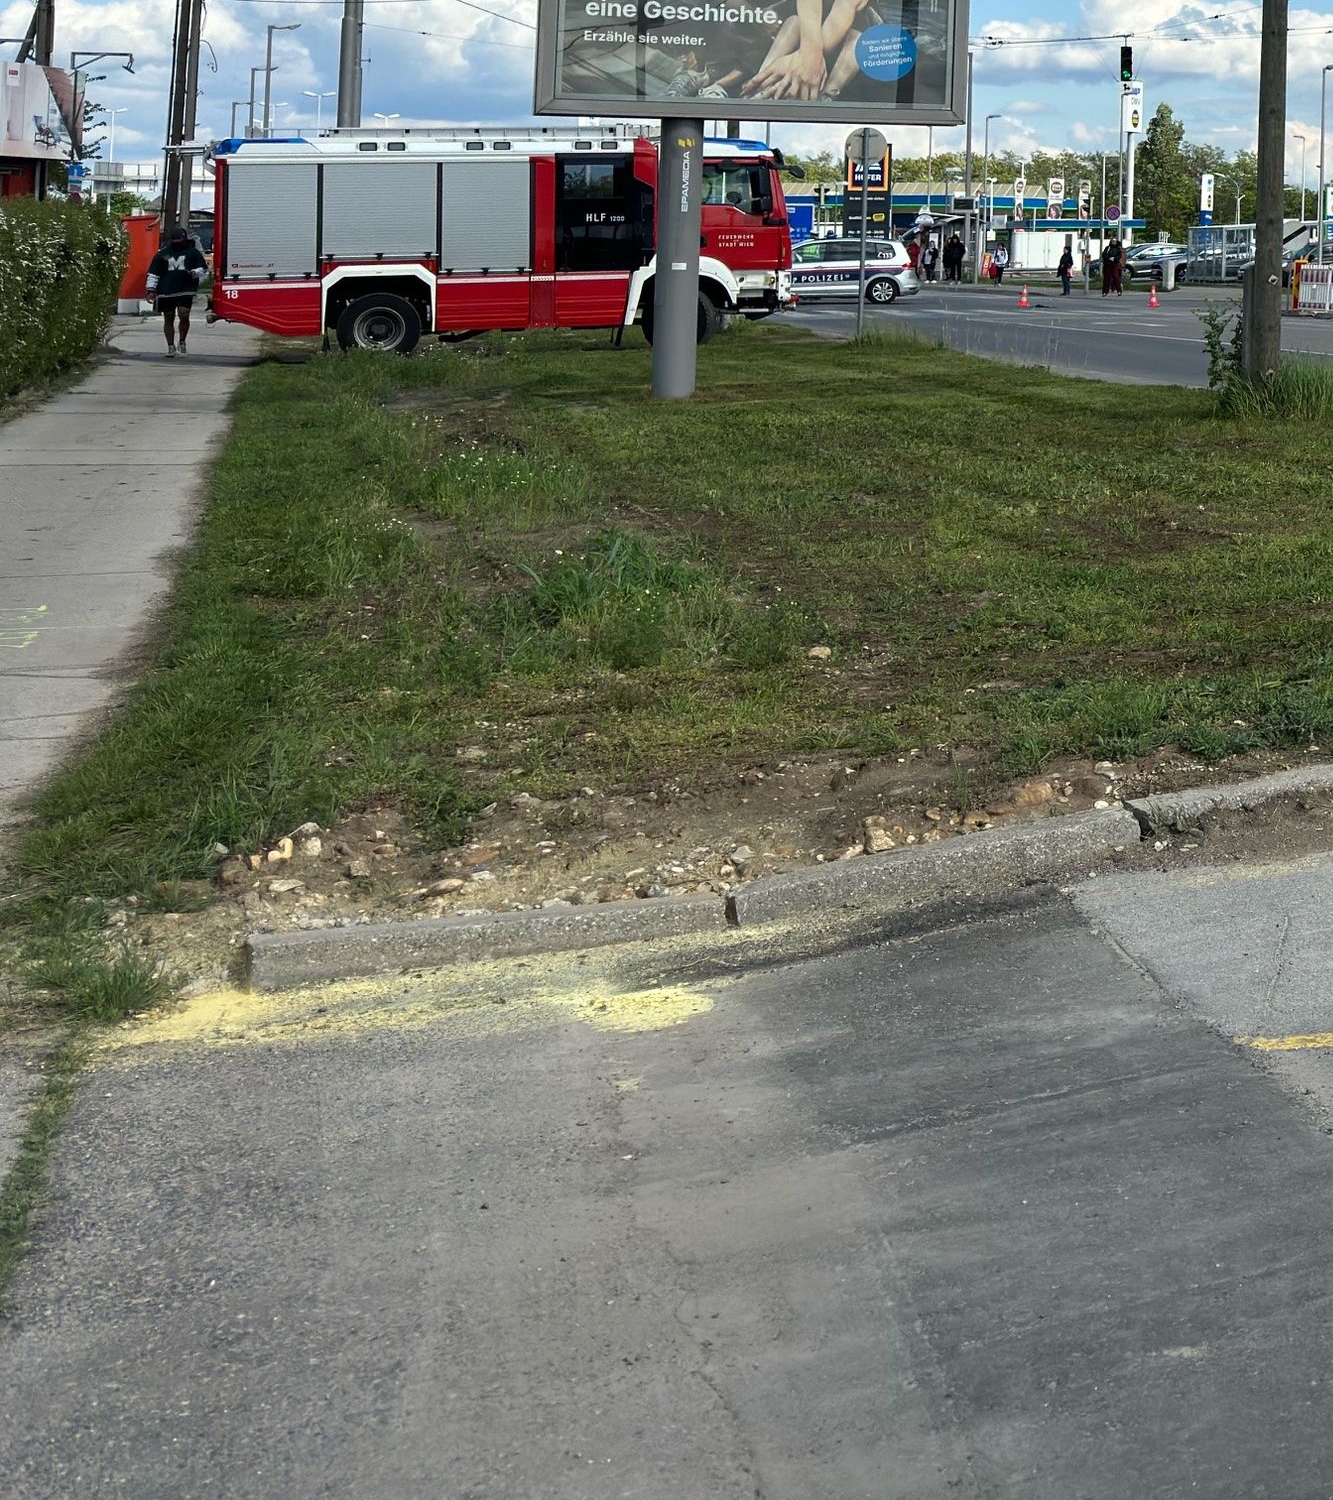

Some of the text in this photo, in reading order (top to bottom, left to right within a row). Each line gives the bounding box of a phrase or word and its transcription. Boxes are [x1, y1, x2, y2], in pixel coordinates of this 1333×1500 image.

[643, 0, 783, 25] Geschichte.
[584, 30, 707, 46] Erzähle sie weiter.
[681, 151, 690, 212] EPAMEDIA
[586, 212, 606, 222] HLF
[168, 255, 186, 271] M
[801, 274, 843, 282] POLIZEI
[225, 290, 239, 299] 18
